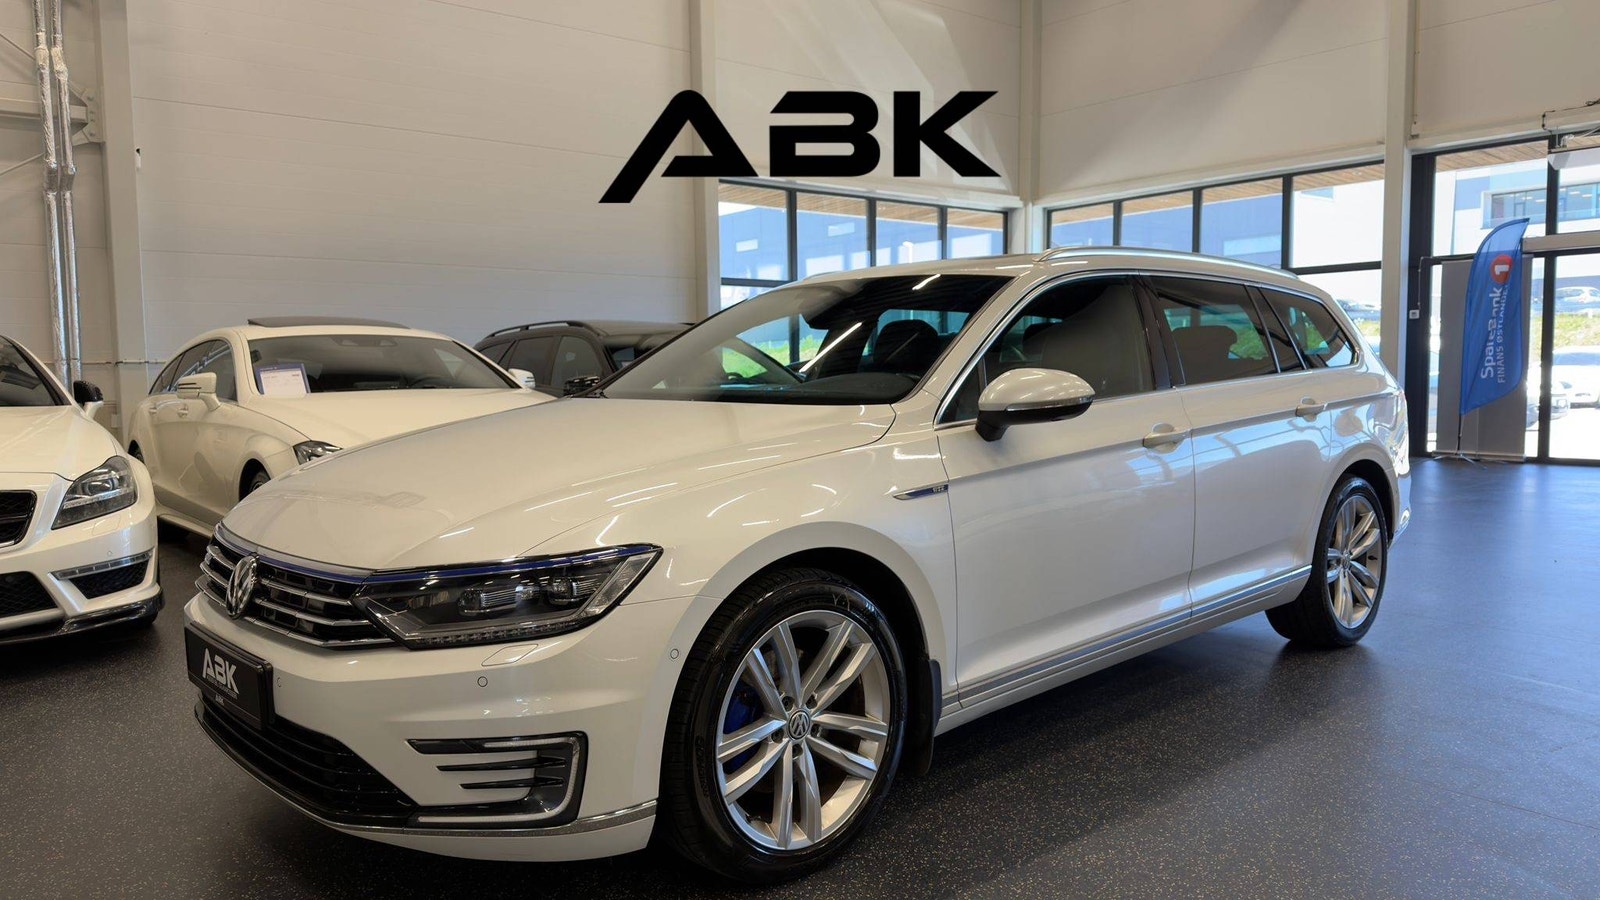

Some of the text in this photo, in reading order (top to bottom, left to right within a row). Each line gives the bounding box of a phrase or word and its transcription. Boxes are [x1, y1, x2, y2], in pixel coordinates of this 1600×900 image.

[1494, 264, 1510, 275] 1
[1495, 284, 1510, 384] FINANS ØSTLANDE
[202, 648, 240, 695] ABK
